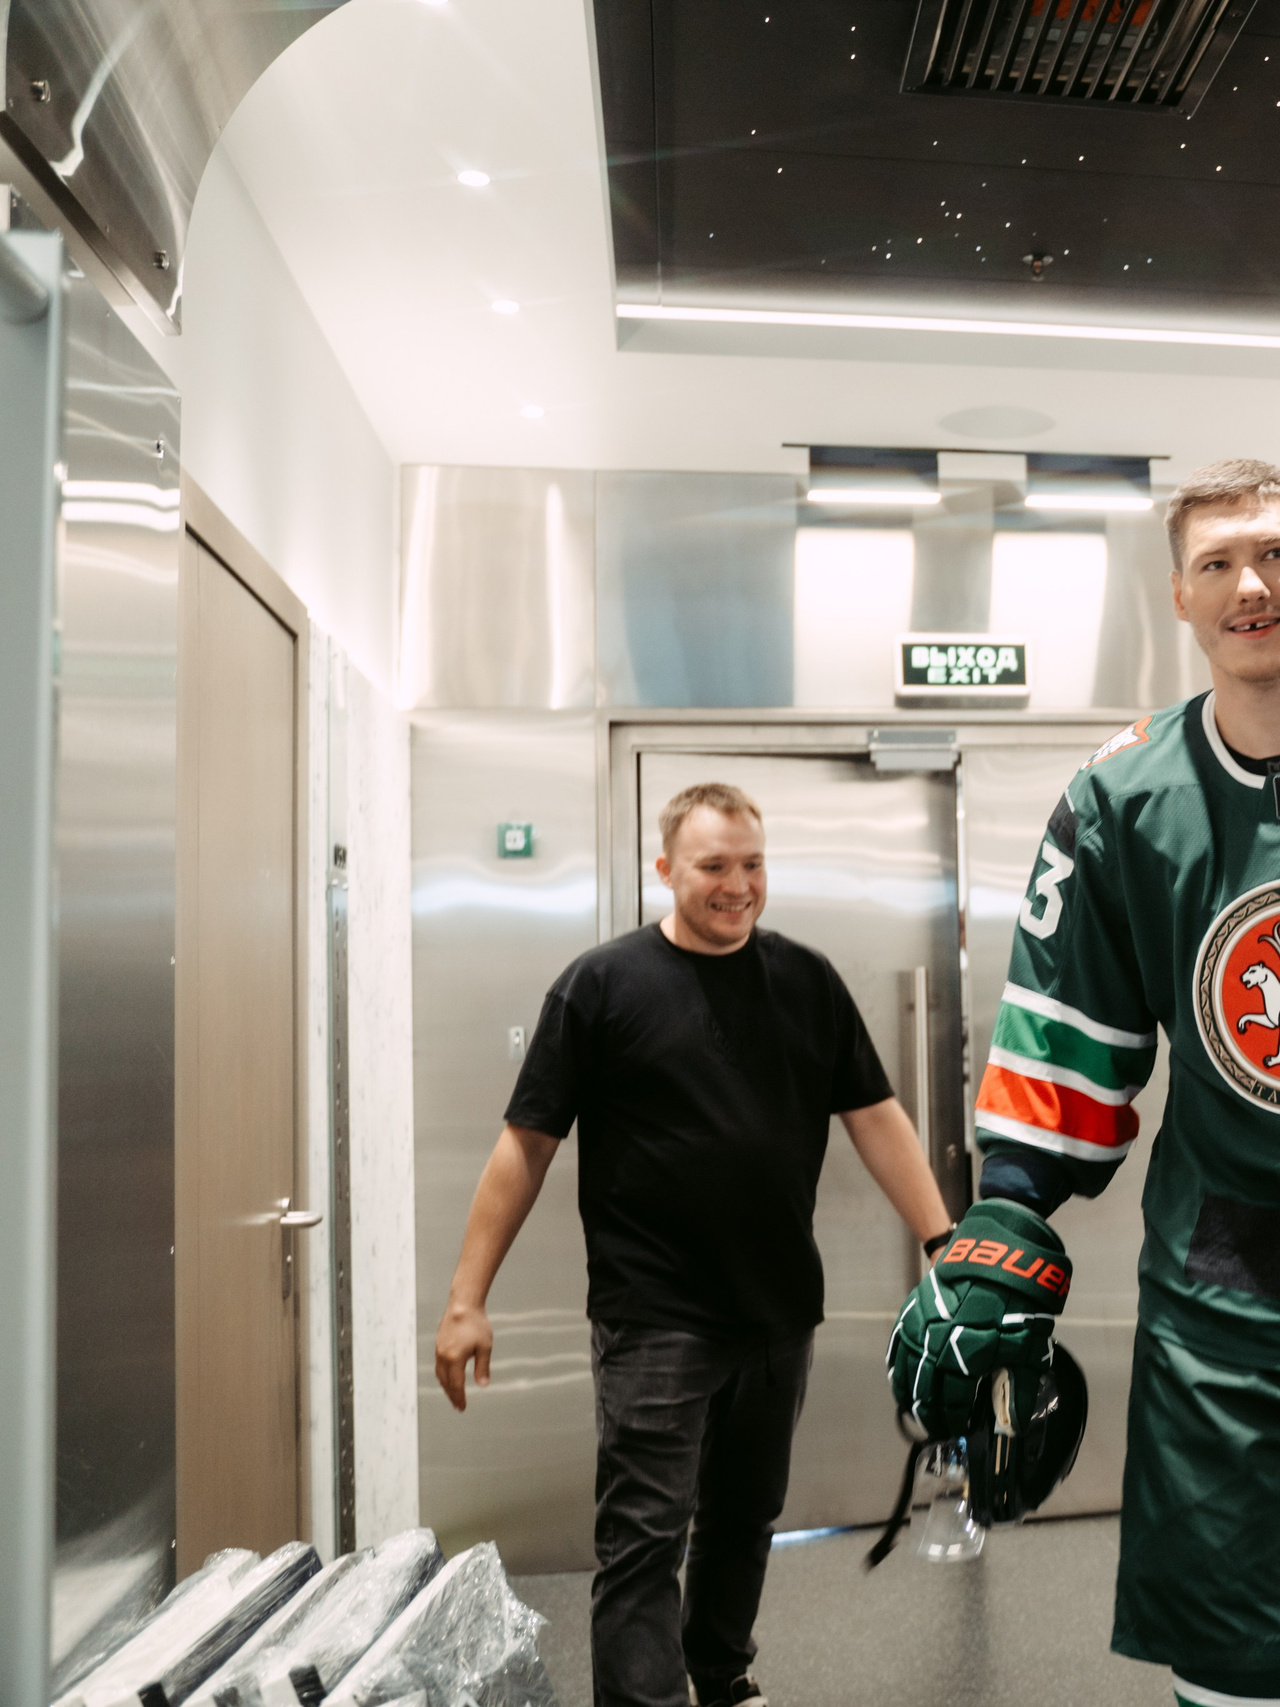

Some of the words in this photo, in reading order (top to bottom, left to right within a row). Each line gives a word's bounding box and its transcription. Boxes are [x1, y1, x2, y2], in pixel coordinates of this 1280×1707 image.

[911, 646, 1018, 673] ВЫХОД
[927, 667, 998, 684] EXIT
[1020, 840, 1075, 940] 3
